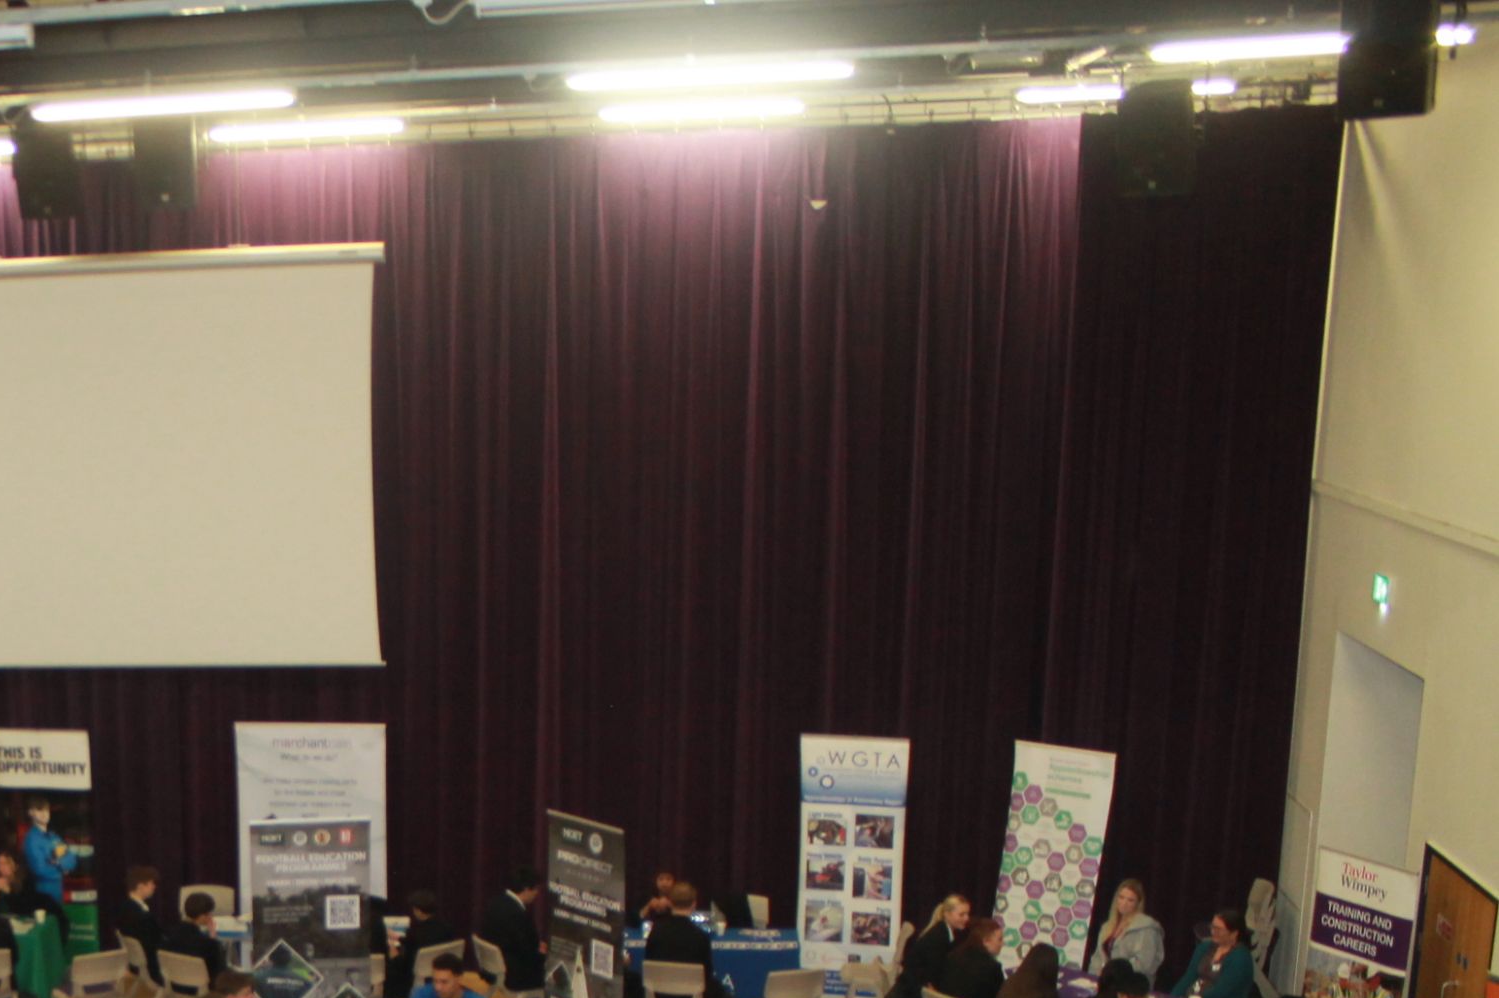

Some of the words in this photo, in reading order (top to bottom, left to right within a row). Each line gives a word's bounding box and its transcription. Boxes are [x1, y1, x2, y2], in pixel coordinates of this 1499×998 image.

[30, 747, 42, 759] IS
[828, 751, 900, 769] WGTA
[255, 852, 306, 864] FOOTBALL
[309, 851, 366, 862] EDUCATION
[1342, 862, 1378, 882] Taylor
[1341, 874, 1387, 902] Wimpey
[1328, 901, 1370, 923] TRAINING
[1372, 915, 1392, 930] AND
[1321, 915, 1393, 947] CONSTRUCTION
[1333, 934, 1377, 957] CAREERS
